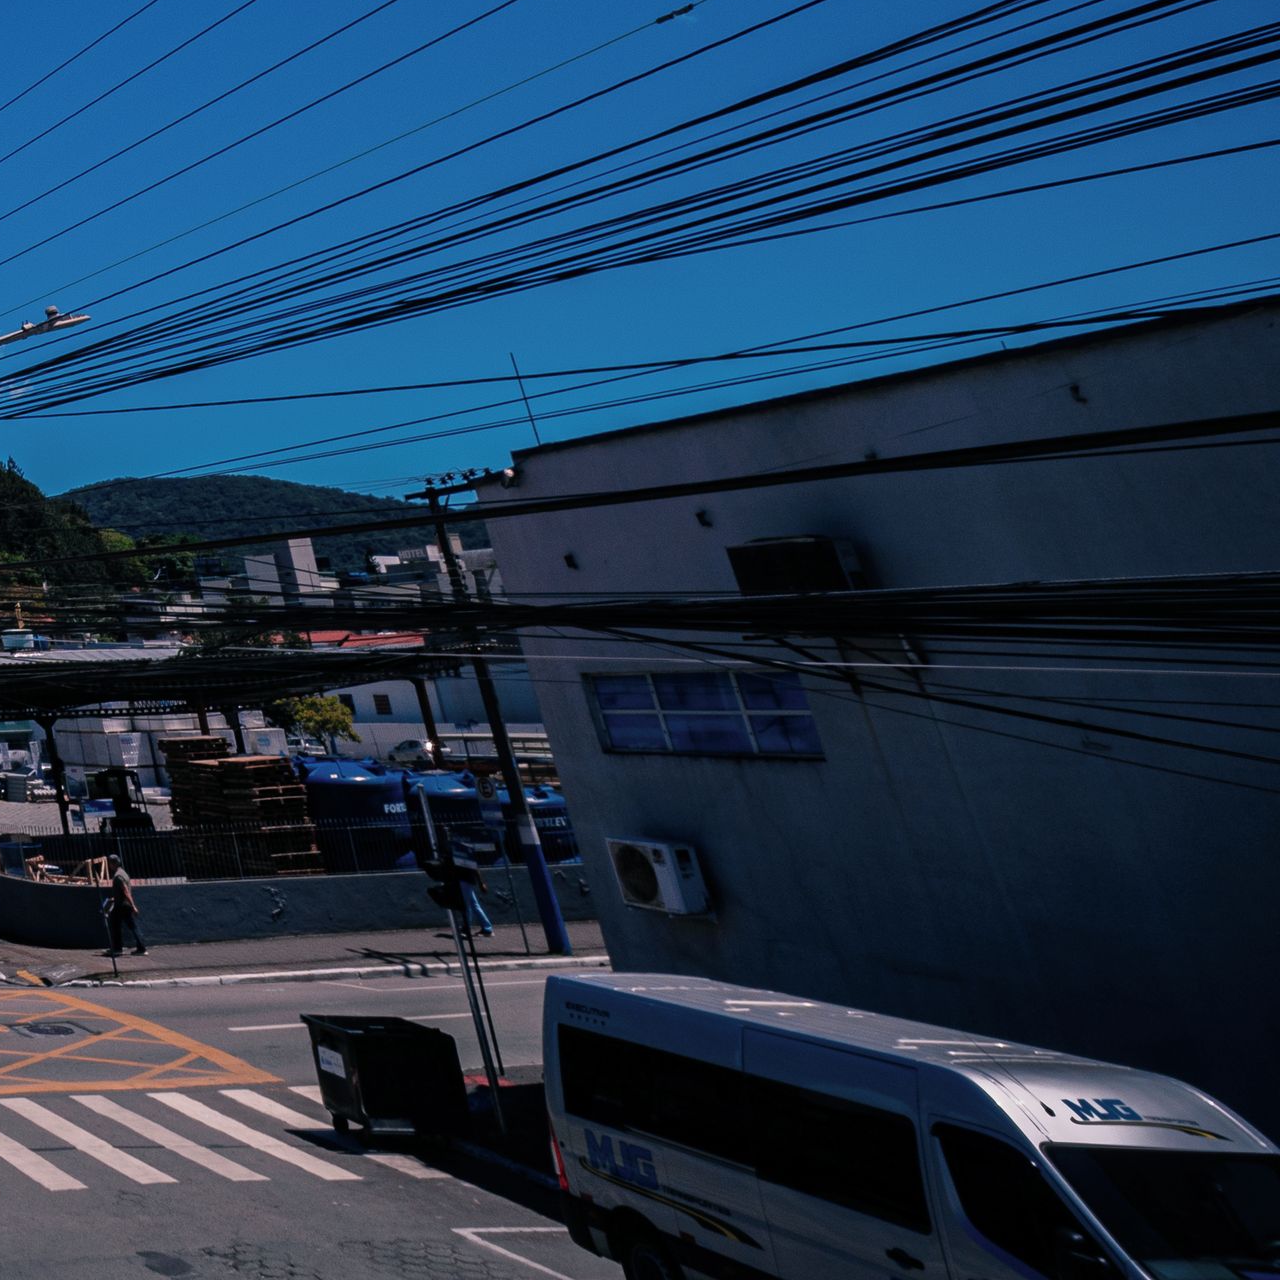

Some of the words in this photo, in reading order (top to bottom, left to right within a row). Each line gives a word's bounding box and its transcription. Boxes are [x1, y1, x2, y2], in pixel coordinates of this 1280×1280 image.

[398, 549, 426, 560] HOTEL
[1061, 1099, 1144, 1121] MJG
[584, 1128, 659, 1189] MJG
